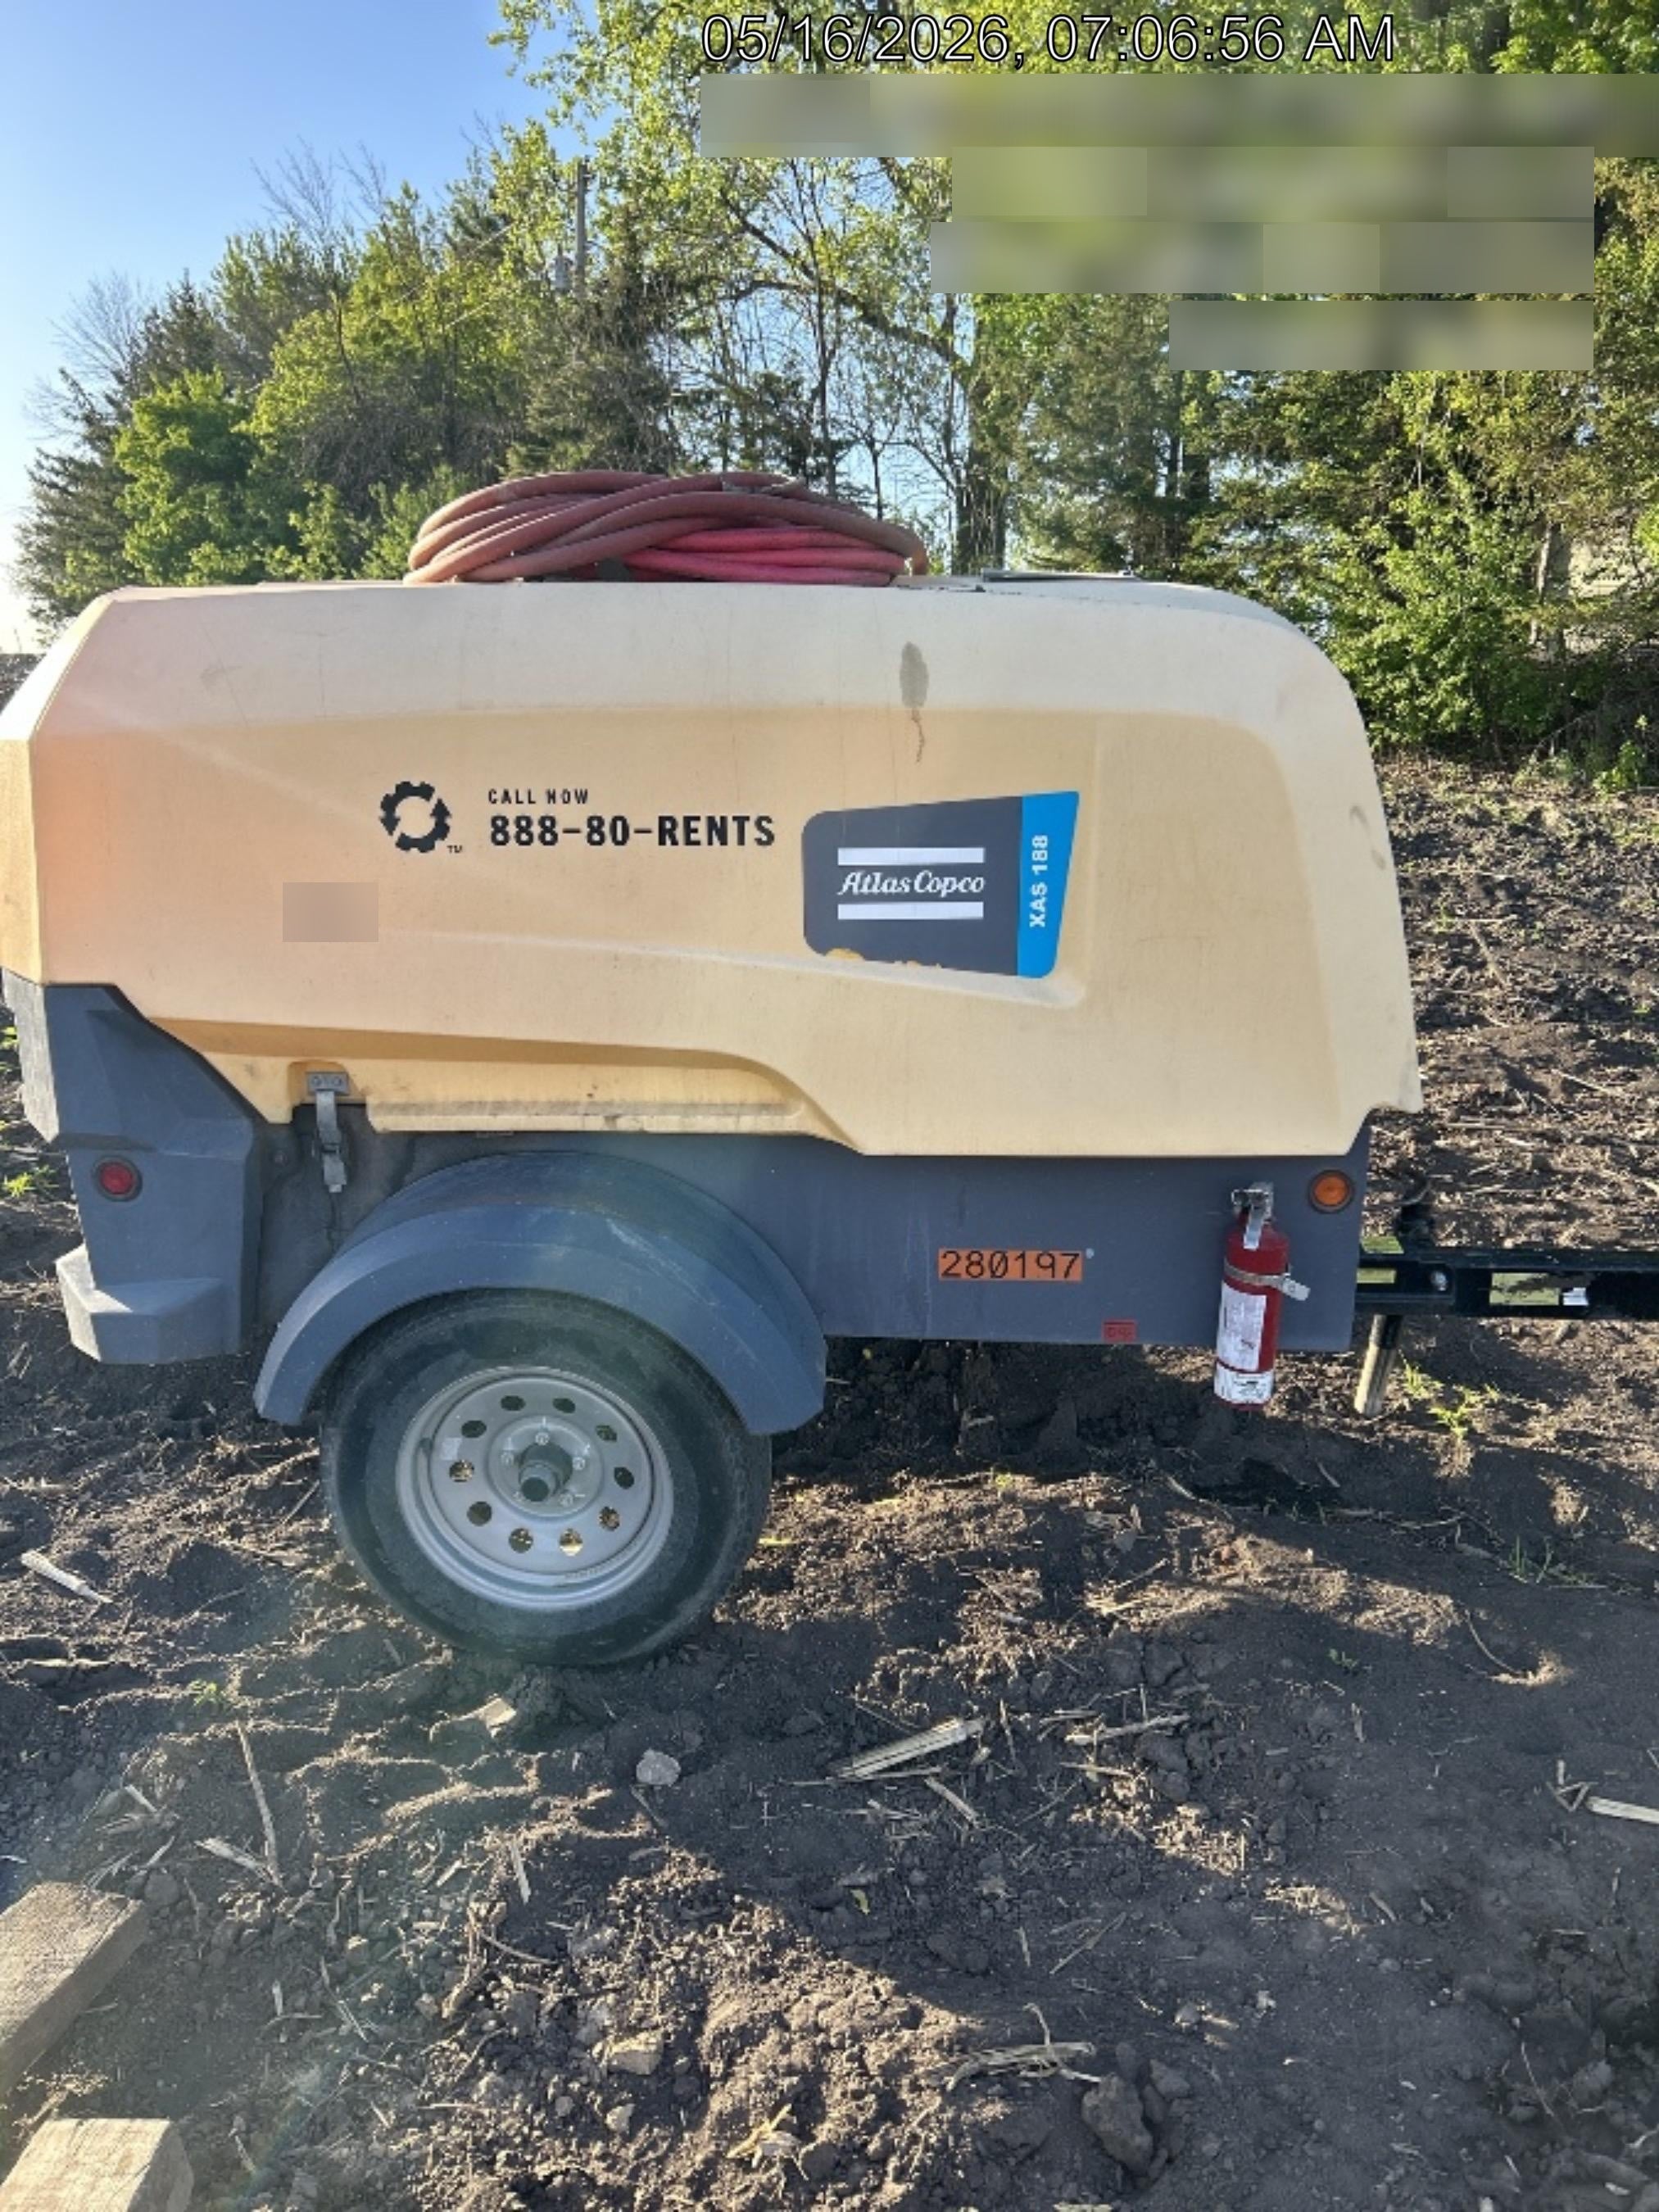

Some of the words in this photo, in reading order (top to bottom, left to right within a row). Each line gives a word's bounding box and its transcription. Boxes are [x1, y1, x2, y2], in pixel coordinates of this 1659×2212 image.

[488, 789, 537, 805] CALL
[547, 789, 589, 805] NOW
[490, 815, 775, 846] 888-80-RENTS
[1031, 835, 1049, 875] 188
[1029, 882, 1048, 927] XAS
[941, 1250, 1081, 1279] 280197
